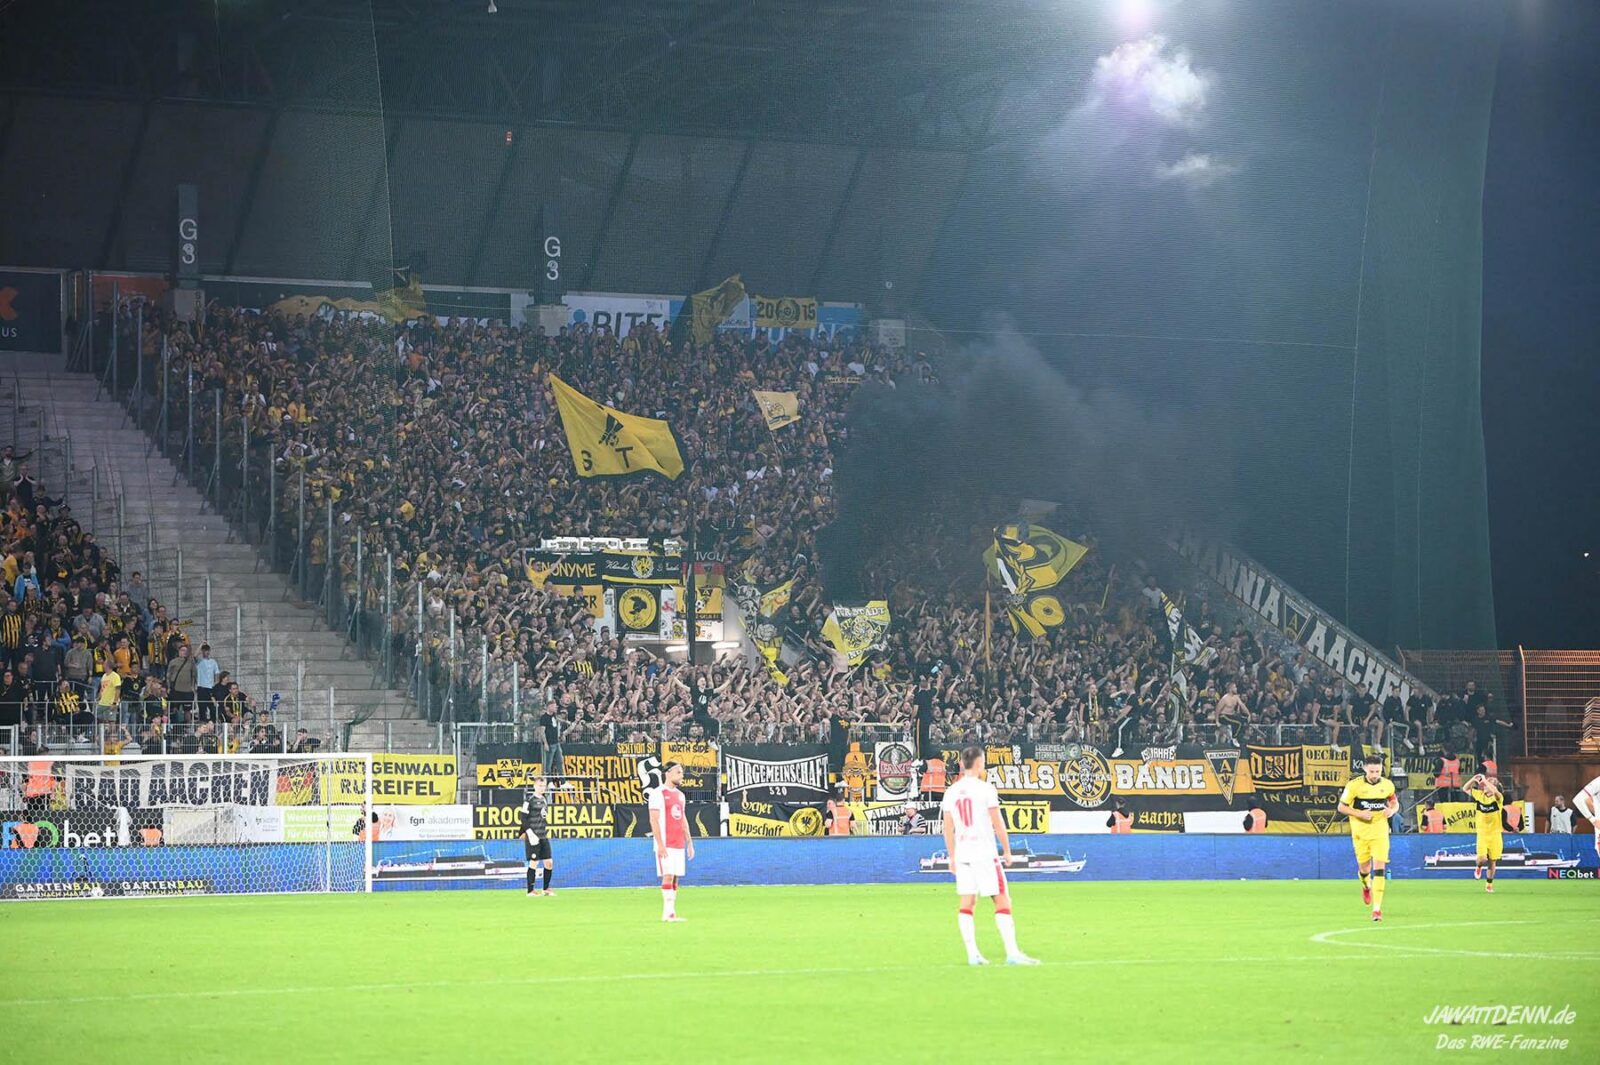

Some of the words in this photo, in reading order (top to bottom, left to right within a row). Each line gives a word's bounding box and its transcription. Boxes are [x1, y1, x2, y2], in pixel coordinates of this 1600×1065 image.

[179, 218, 198, 240] G
[544, 236, 561, 258] G
[726, 756, 829, 791] FAHRGEMEINSCHAFT
[410, 816, 425, 826] fgn
[955, 798, 973, 827] 10
[121, 880, 204, 891] GARTENBAU
